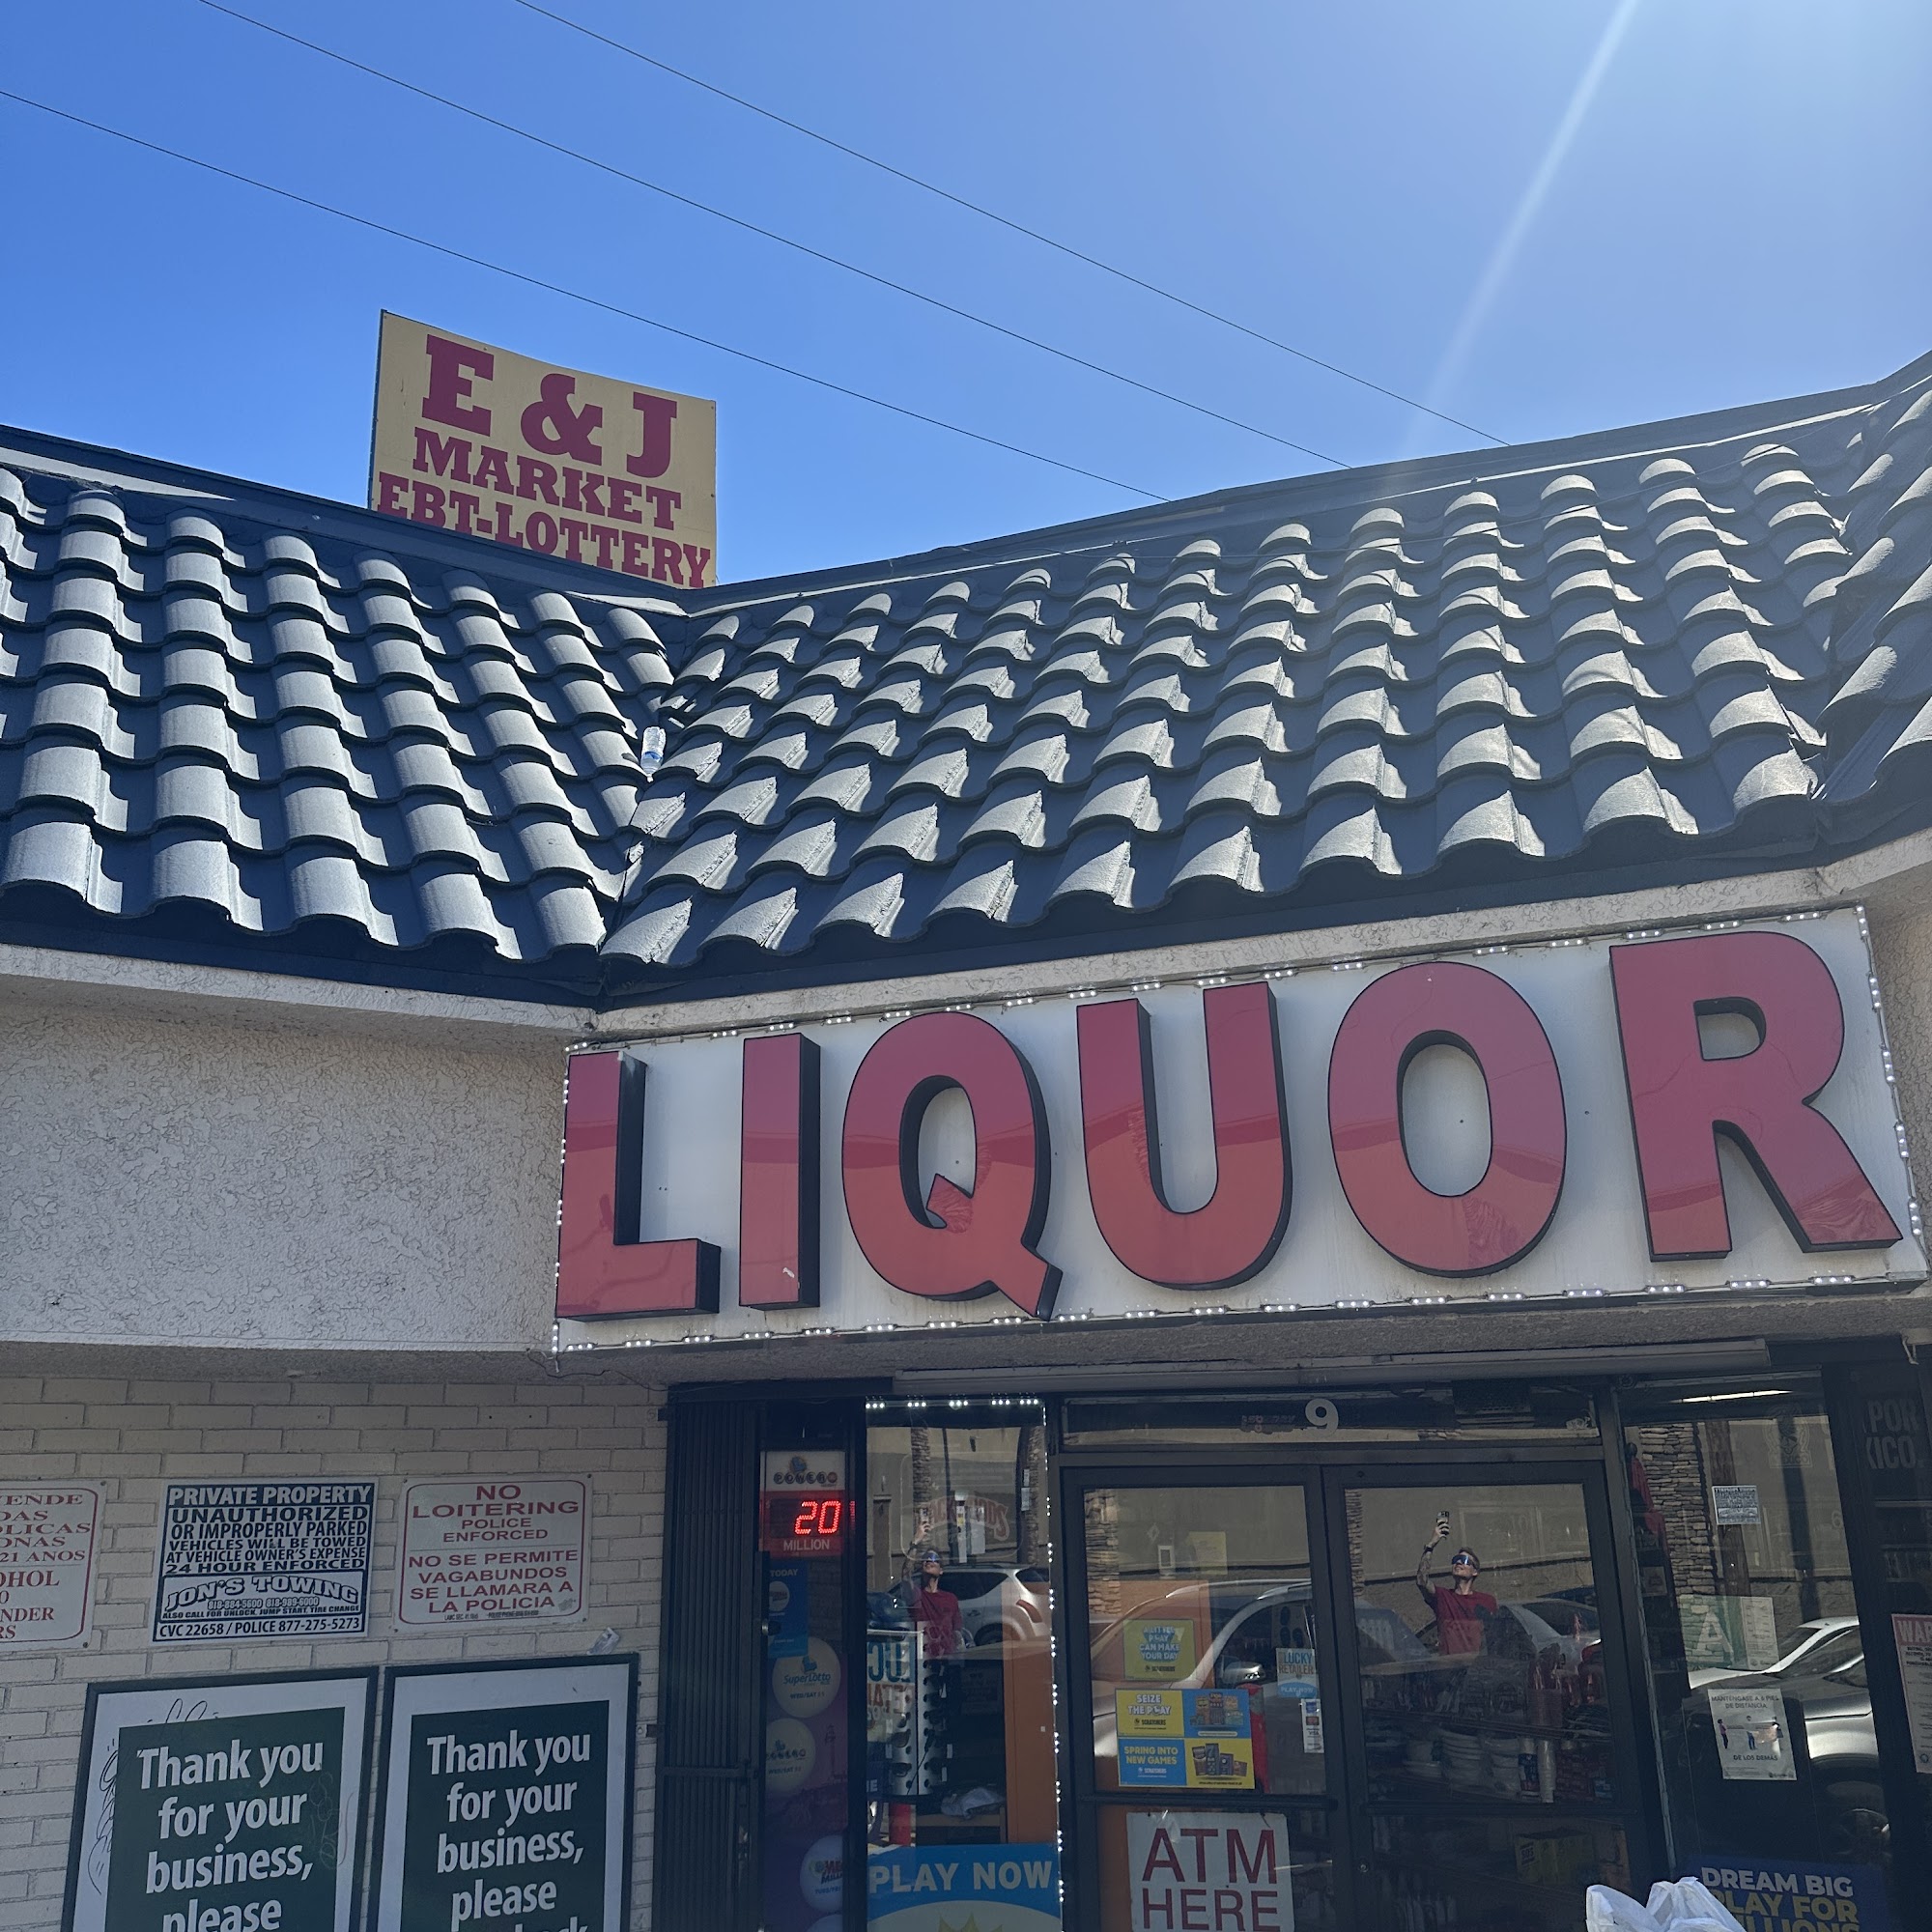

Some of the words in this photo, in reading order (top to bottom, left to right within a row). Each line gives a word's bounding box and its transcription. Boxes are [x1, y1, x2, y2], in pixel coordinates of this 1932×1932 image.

[422, 334, 494, 436] E
[521, 373, 603, 466] &
[626, 391, 677, 478] J
[412, 426, 681, 530] MARKET
[378, 471, 710, 588] EBT-LOTTERY
[555, 931, 1902, 1321] LIQUOR
[1305, 1398, 1339, 1437] 9
[0, 1494, 83, 1506] ENDE
[169, 1487, 258, 1506] PRIVATE
[262, 1486, 371, 1504] PROPERTY
[476, 1485, 522, 1500] NO
[172, 1506, 368, 1523] UNAUTHORIZED
[412, 1501, 580, 1518] LOITERING
[794, 1500, 840, 1536] 20
[0, 1522, 91, 1535] LICAS
[171, 1523, 194, 1539] OR
[199, 1521, 302, 1539] IMPROPERLY
[306, 1520, 367, 1537] PARKED
[461, 1518, 531, 1530] POLICE
[169, 1539, 243, 1551] VEHICLES
[247, 1538, 285, 1549] WILL
[290, 1537, 308, 1548] BE
[313, 1536, 366, 1548] TOWED
[443, 1529, 548, 1543] ENFORCED
[783, 1539, 830, 1551] MILLION
[165, 1550, 184, 1564] AT
[185, 1549, 242, 1563] VEHICLE
[244, 1548, 306, 1561] OWNER'S
[310, 1547, 366, 1559] EXPENSE
[409, 1555, 441, 1568] NO
[449, 1553, 477, 1566] SE
[484, 1549, 579, 1565] PERMITE
[165, 1563, 191, 1574] 24
[198, 1561, 256, 1573] HOUR
[262, 1558, 365, 1572] ENFORCED
[418, 1566, 567, 1584] VAGABUNDOS
[164, 1577, 245, 1612] JON'S
[252, 1575, 359, 1605] TOWING
[411, 1587, 439, 1600] SE
[446, 1582, 553, 1599] LLAMARA
[558, 1581, 574, 1592] A
[428, 1601, 458, 1614] LA
[466, 1596, 555, 1612] POLICIA
[159, 1625, 185, 1637] CVC
[186, 1622, 224, 1636] 22658
[235, 1620, 276, 1634] POLICE
[278, 1617, 359, 1632] 877-275-5273
[1696, 1610, 1733, 1658] A
[1157, 1642, 1180, 1651] MAKE
[1284, 1652, 1313, 1664] LUCKY
[1279, 1664, 1314, 1675] RETAILER
[1136, 1694, 1162, 1704] SEIZE
[1127, 1705, 1146, 1716] THE
[426, 1729, 527, 1776] Thank
[534, 1734, 591, 1776] you
[1124, 1746, 1155, 1755] SPRING
[1156, 1746, 1179, 1755] INTO
[1126, 1756, 1147, 1765] NEW
[1149, 1755, 1178, 1765] GAMES
[136, 1739, 252, 1789] Thank
[259, 1742, 324, 1788] you
[446, 1782, 497, 1822] for
[505, 1781, 578, 1828] your
[157, 1796, 214, 1839] for
[224, 1793, 307, 1844] your
[437, 1828, 584, 1873] business,
[1142, 1828, 1277, 1884] ATM
[146, 1843, 314, 1893] business,
[868, 1863, 959, 1894] PLAY
[973, 1861, 1053, 1890] NOW
[1701, 1867, 1799, 1894] DREAM
[1804, 1875, 1854, 1897] BIG
[162, 1898, 283, 1932] please
[451, 1879, 557, 1932] please
[1142, 1888, 1280, 1932] HERE
[1792, 1896, 1859, 1923] FOR
